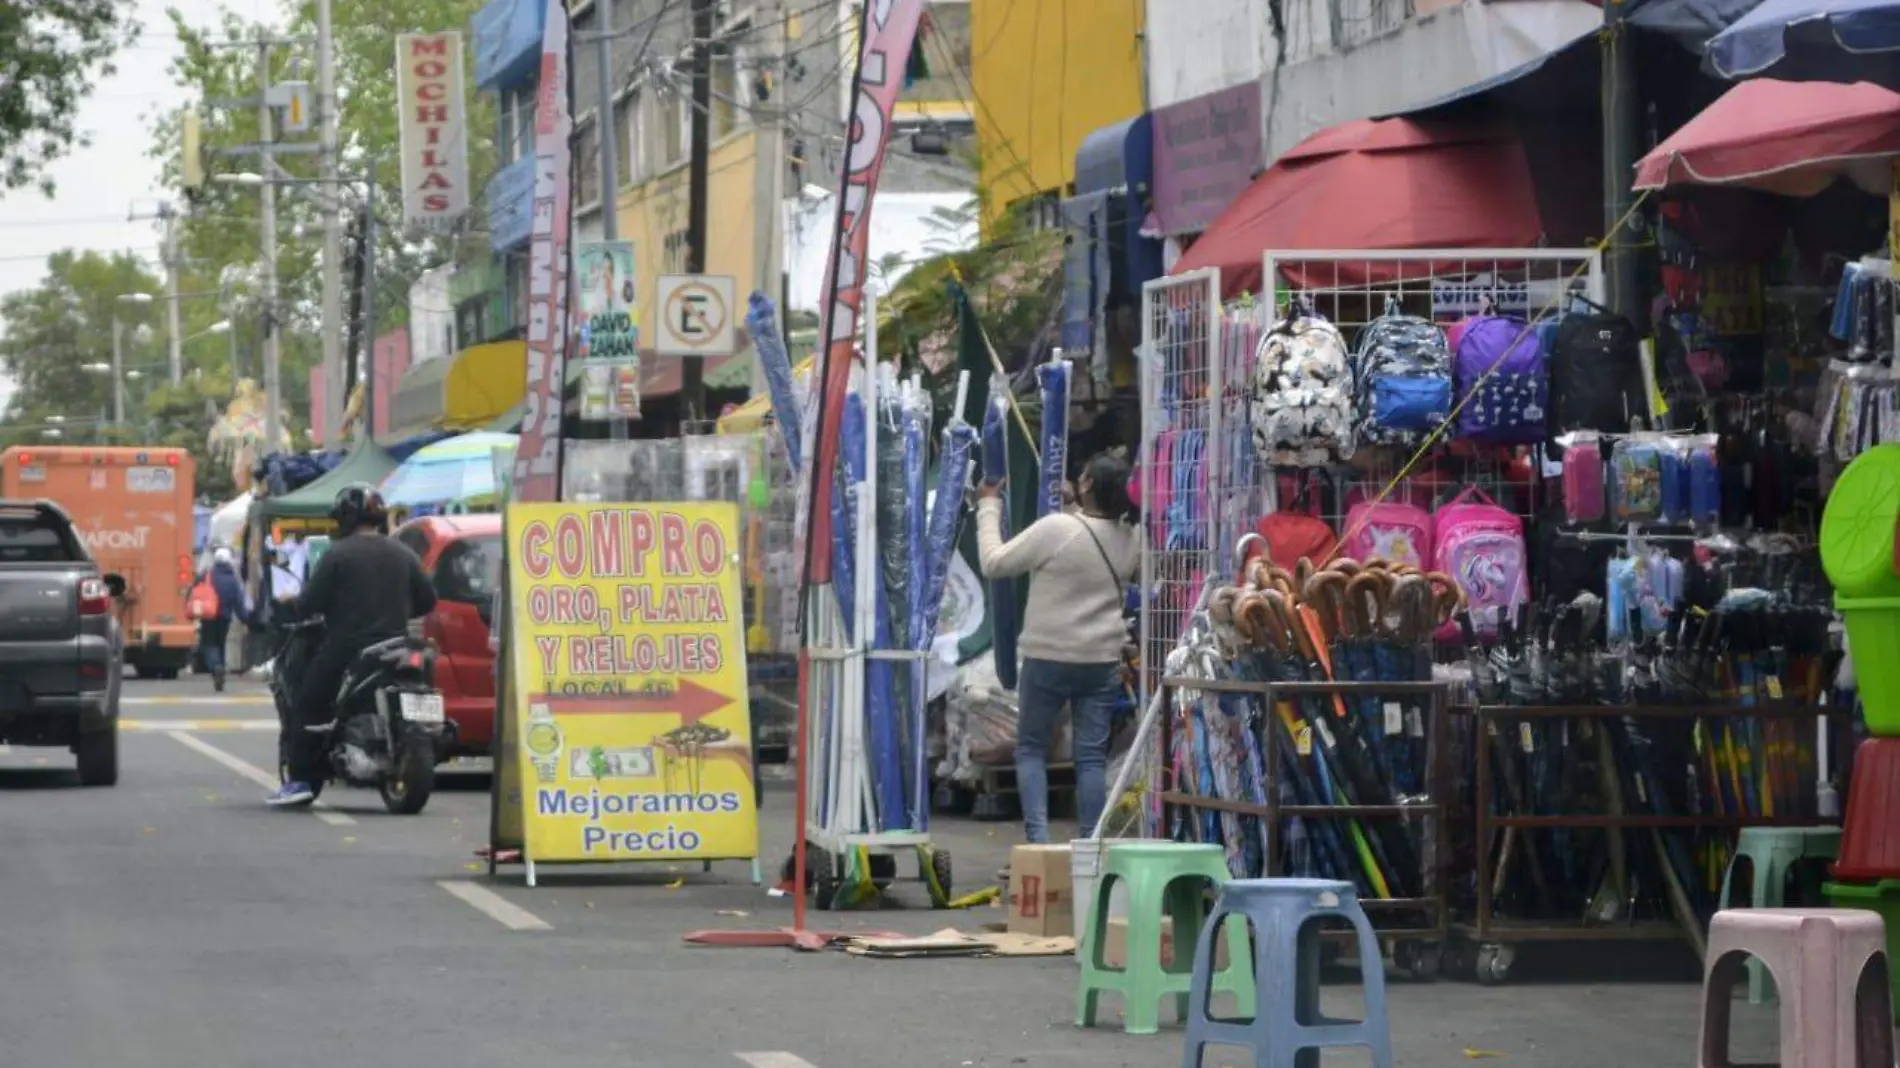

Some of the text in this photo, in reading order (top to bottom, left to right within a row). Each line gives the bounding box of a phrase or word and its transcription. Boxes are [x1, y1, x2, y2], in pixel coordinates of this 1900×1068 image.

[411, 37, 452, 212] MOCHILAS
[681, 295, 707, 333] E
[522, 509, 725, 578] COMPRO
[529, 583, 727, 633] ORO, PLATA
[536, 634, 723, 676] Y RELOJES
[546, 680, 632, 697] LOCAL
[538, 788, 740, 820] Mejoramos
[583, 825, 700, 851] Precio
